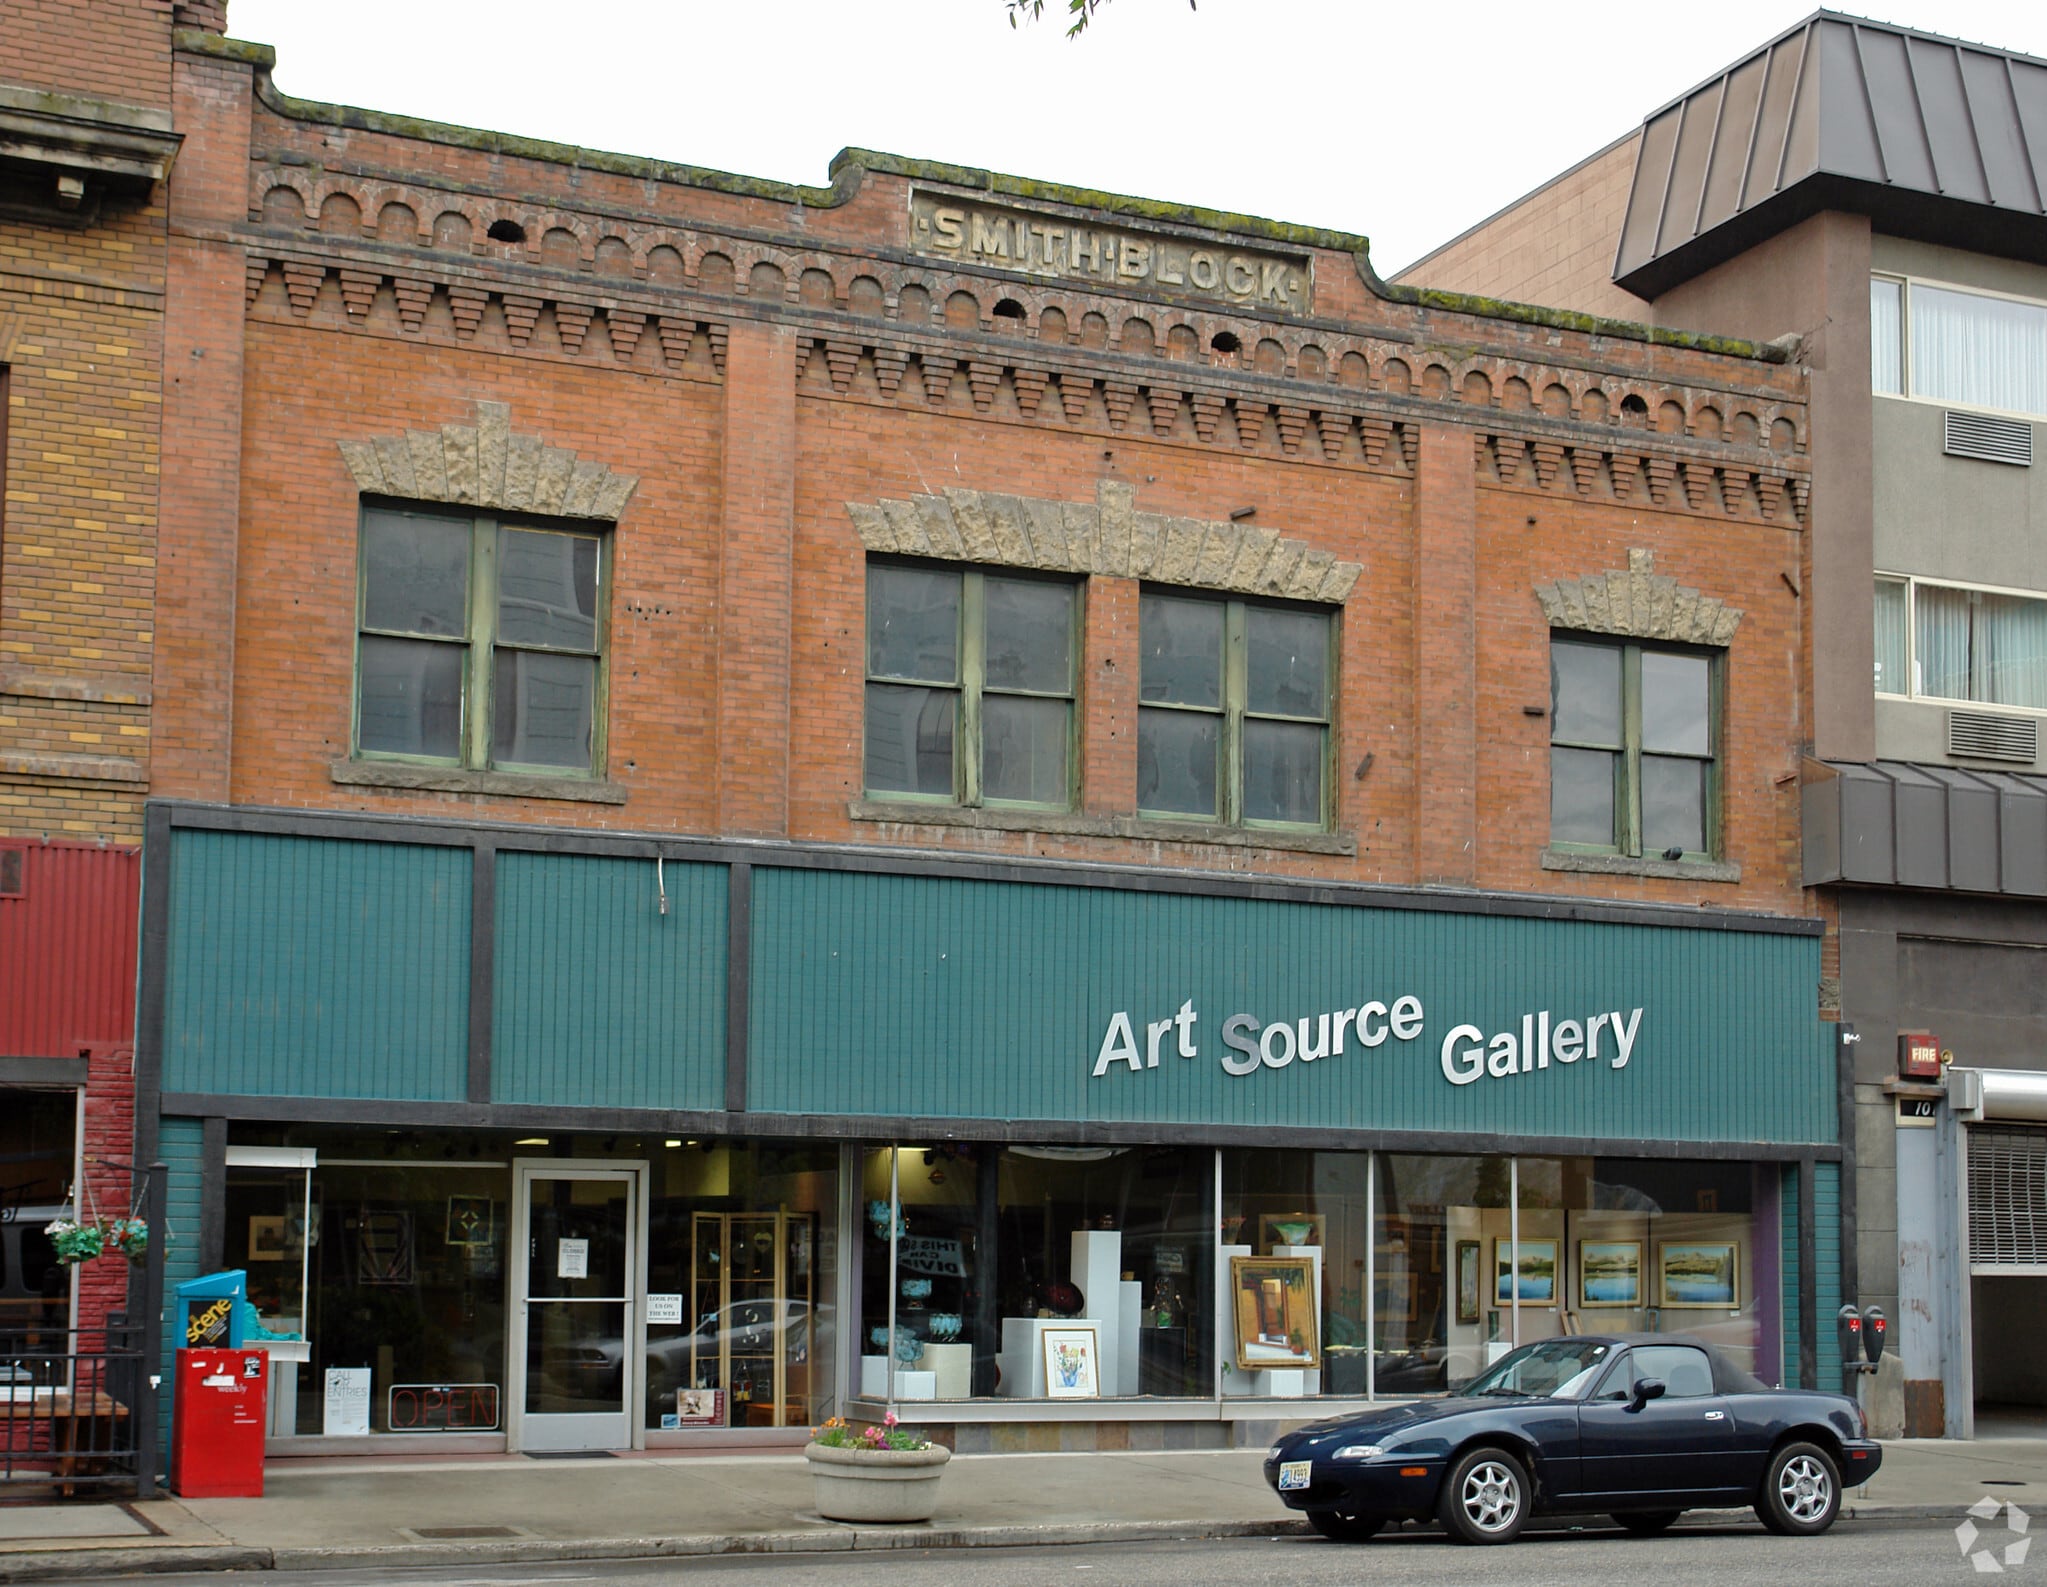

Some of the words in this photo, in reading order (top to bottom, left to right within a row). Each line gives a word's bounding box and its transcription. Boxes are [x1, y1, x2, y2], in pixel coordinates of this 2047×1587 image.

[1092, 998, 1198, 1078] Art
[1220, 994, 1425, 1077] Source
[1440, 1007, 1644, 1087] Gallery
[1911, 1047, 1937, 1063] FIRE
[1915, 1101, 1936, 1116] 10
[186, 1299, 233, 1344] scene
[217, 1383, 248, 1395] weekly
[327, 1386, 368, 1398] ENTRIES
[392, 1390, 495, 1427] OPEN
